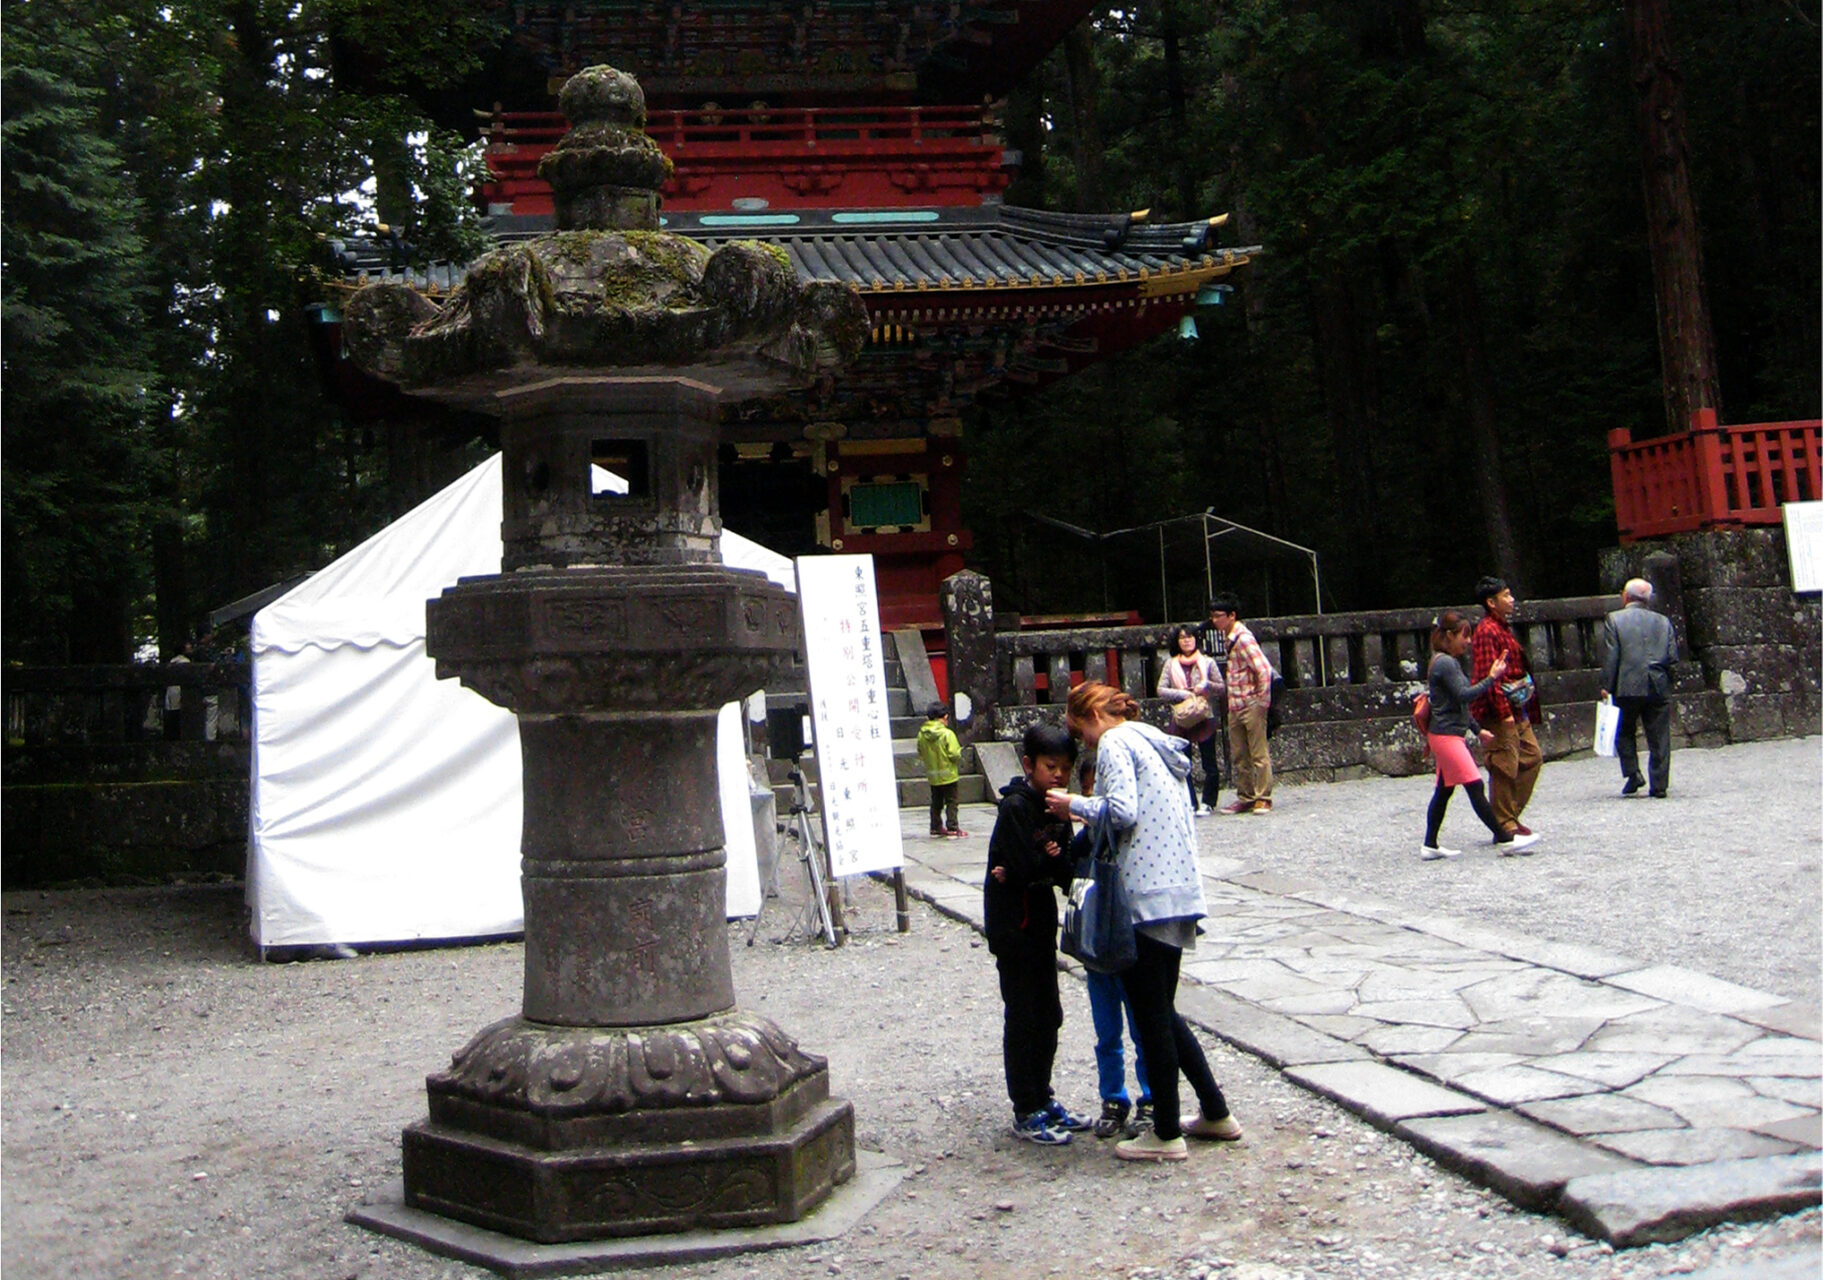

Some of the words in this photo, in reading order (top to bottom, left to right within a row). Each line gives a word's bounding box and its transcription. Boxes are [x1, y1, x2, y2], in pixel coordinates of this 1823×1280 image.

[855, 565, 881, 739] 東照宮五重塔初重心柱
[836, 726, 859, 863] 日光東照宮
